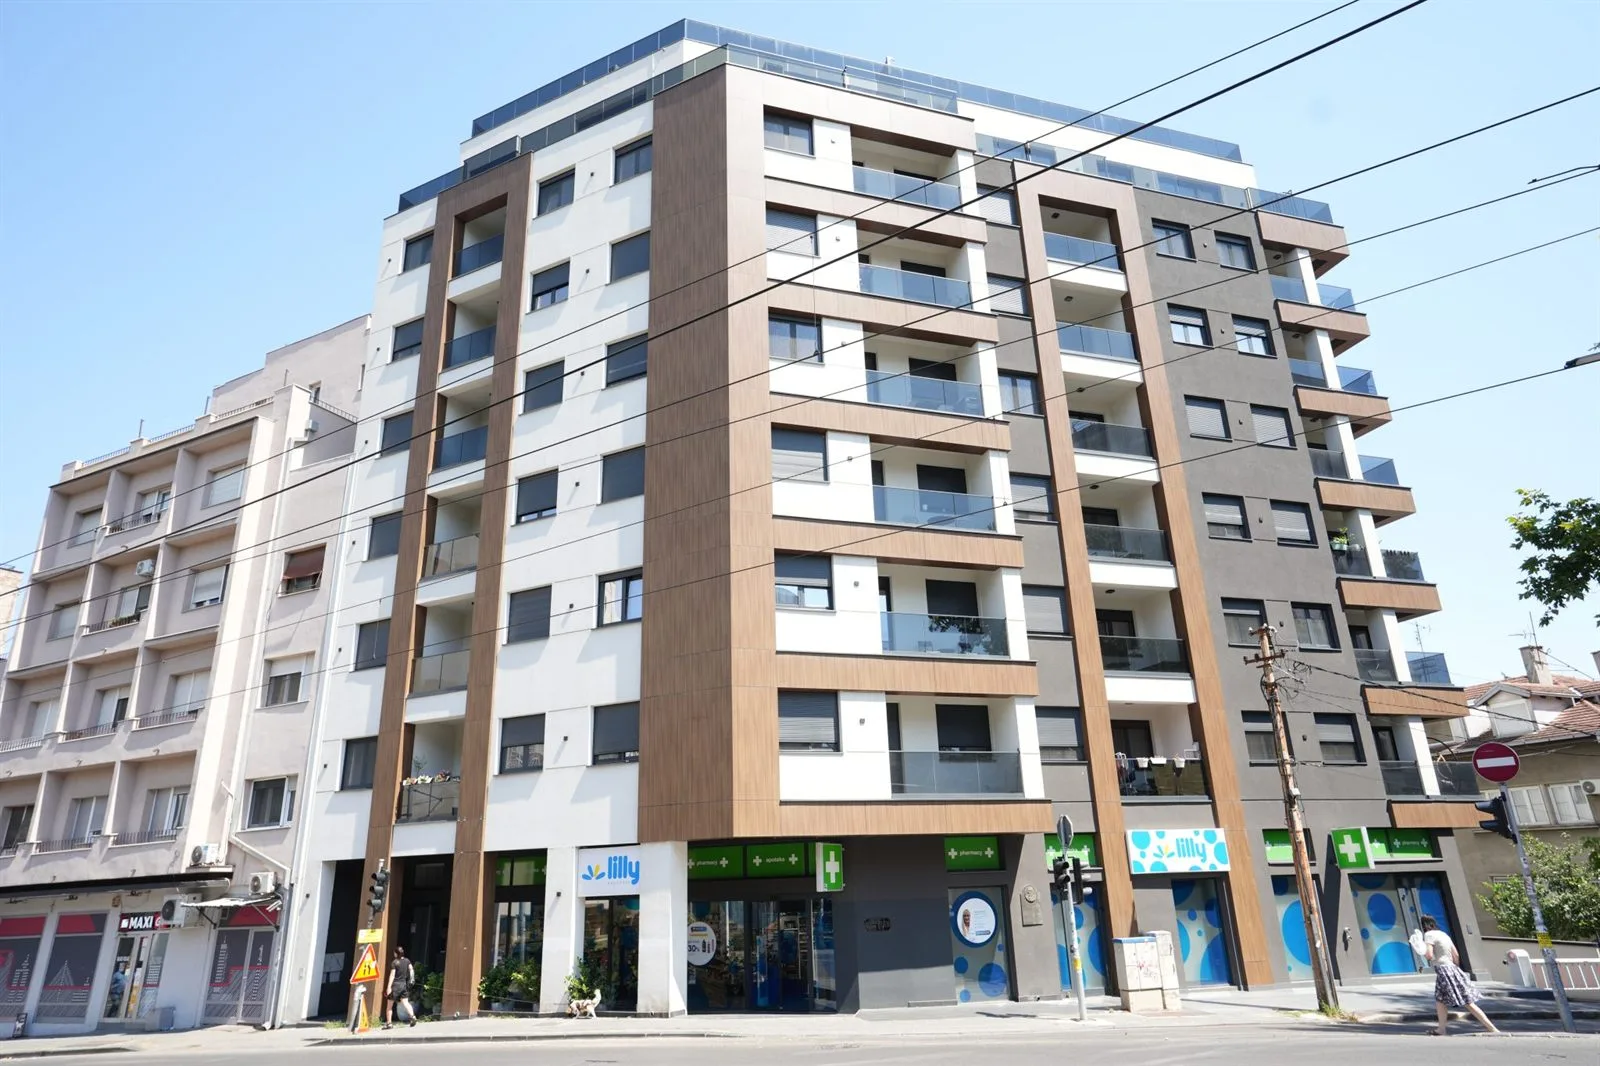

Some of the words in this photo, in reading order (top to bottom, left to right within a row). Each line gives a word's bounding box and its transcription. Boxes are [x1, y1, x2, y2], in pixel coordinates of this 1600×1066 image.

[1175, 837, 1207, 863] lilly
[607, 855, 640, 885] lilly
[128, 915, 154, 929] MAXI
